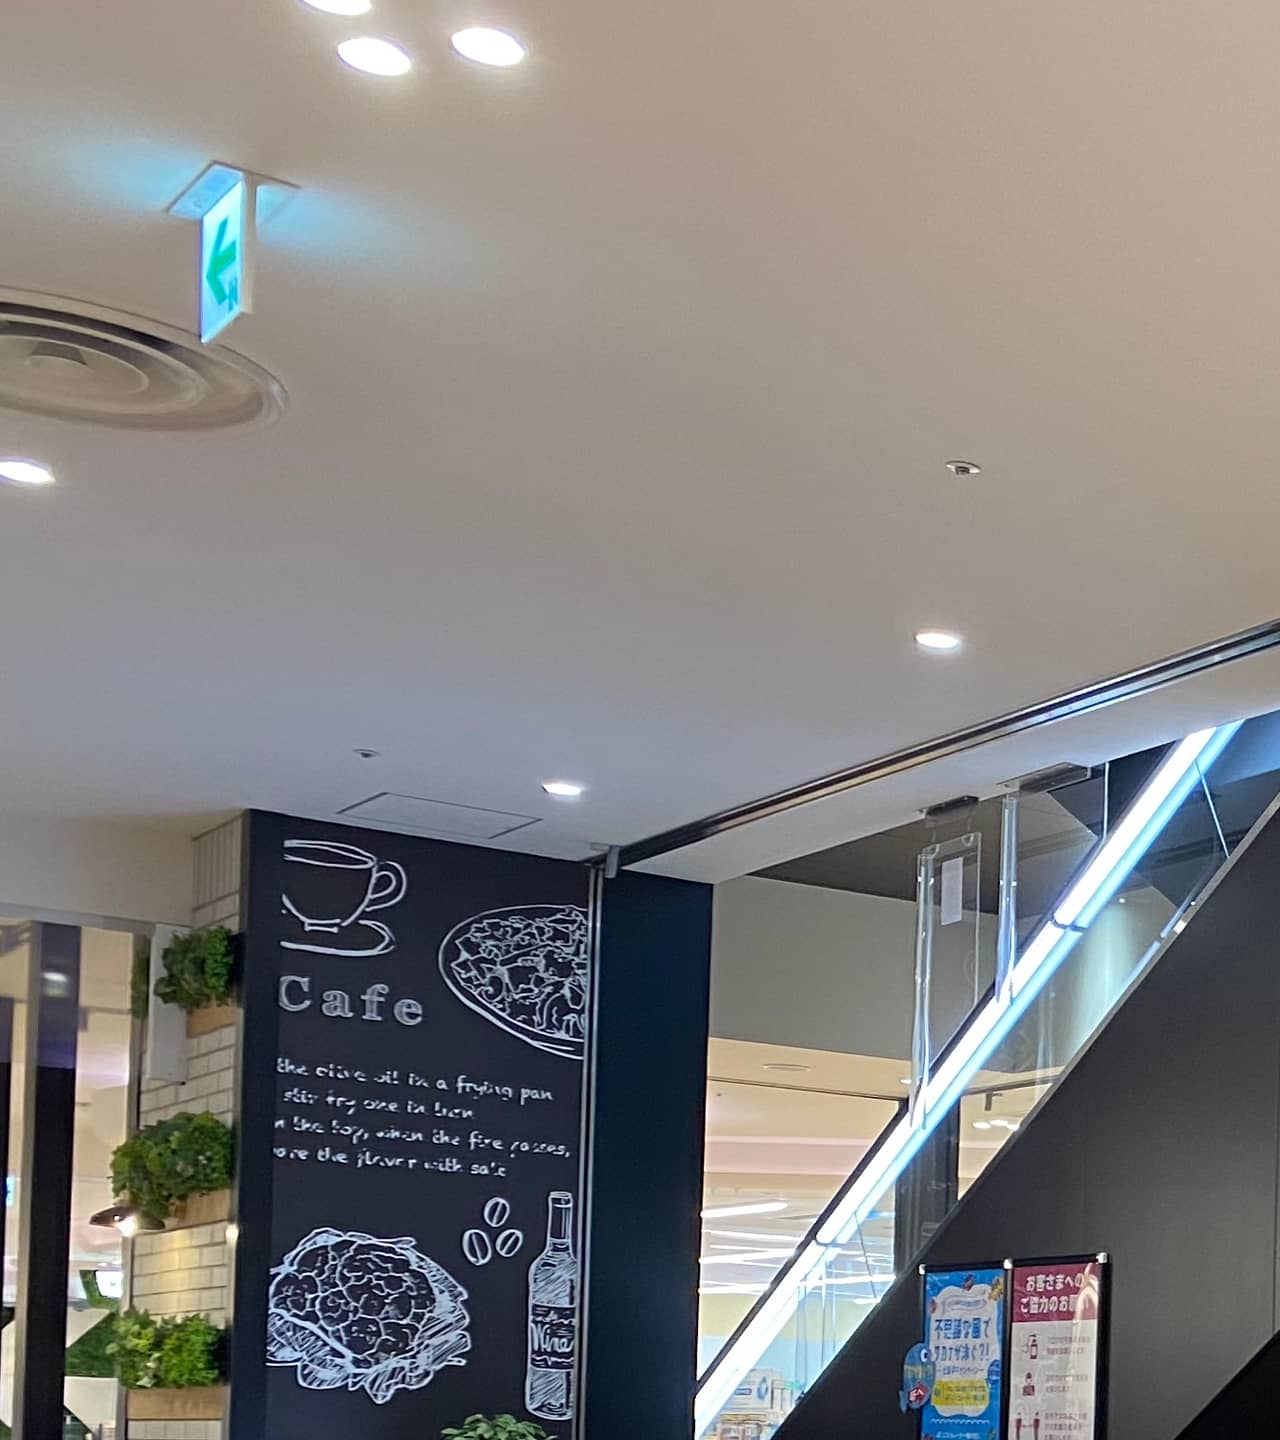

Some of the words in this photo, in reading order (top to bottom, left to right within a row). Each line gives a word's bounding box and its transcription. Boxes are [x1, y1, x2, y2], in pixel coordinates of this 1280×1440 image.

[278, 975, 424, 1026] Cafe
[276, 1057, 310, 1076] the
[373, 1070, 399, 1085] oil
[436, 1078, 448, 1090] a
[456, 1075, 513, 1101] frying
[520, 1087, 553, 1106] pan
[283, 1087, 319, 1105] stir
[407, 1100, 426, 1113] in
[292, 1115, 326, 1133] the
[432, 1129, 461, 1146] the
[468, 1130, 504, 1150] fire
[317, 1146, 349, 1164] the
[424, 1157, 463, 1172] with
[470, 1160, 507, 1177] salt
[530, 1322, 575, 1353] Wine
